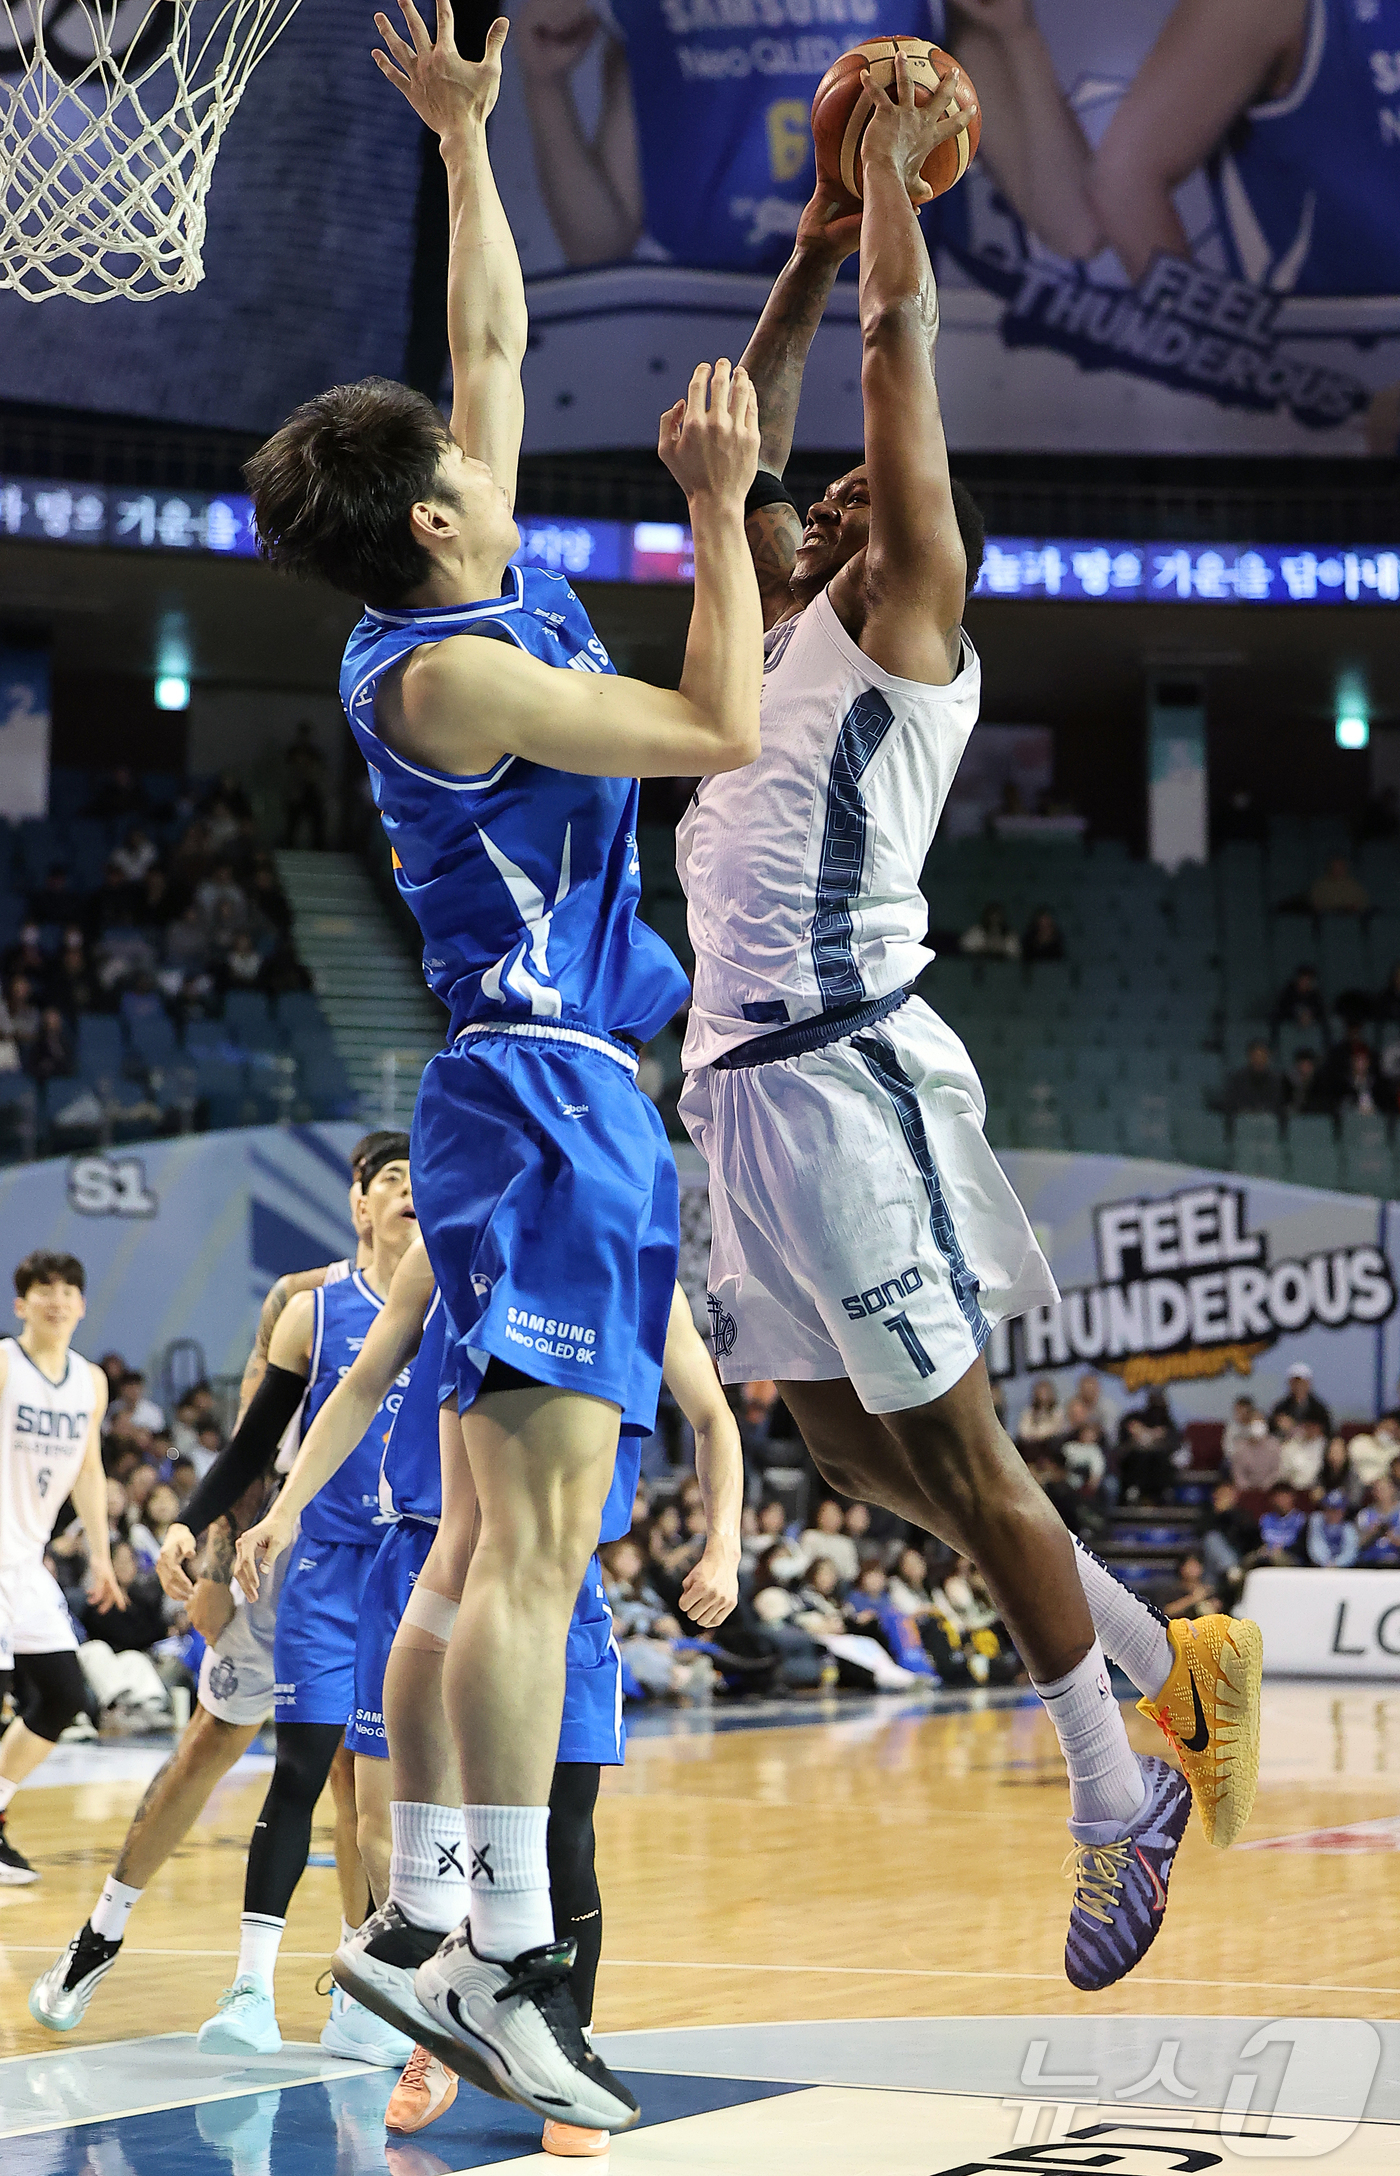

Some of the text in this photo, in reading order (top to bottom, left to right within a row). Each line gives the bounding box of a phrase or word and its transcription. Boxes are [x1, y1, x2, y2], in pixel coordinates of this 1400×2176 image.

[1140, 256, 1270, 344] FEEL
[1013, 264, 1364, 416] THUNDEROUS
[71, 1157, 154, 1213] S1
[1100, 1189, 1262, 1280] FEEL
[505, 1324, 597, 1366] Neo QLED 8K
[507, 1306, 597, 1345] SAMSUNG
[882, 1310, 938, 1380] 1
[355, 1708, 385, 1724] SAM
[355, 1722, 375, 1736] Neo
